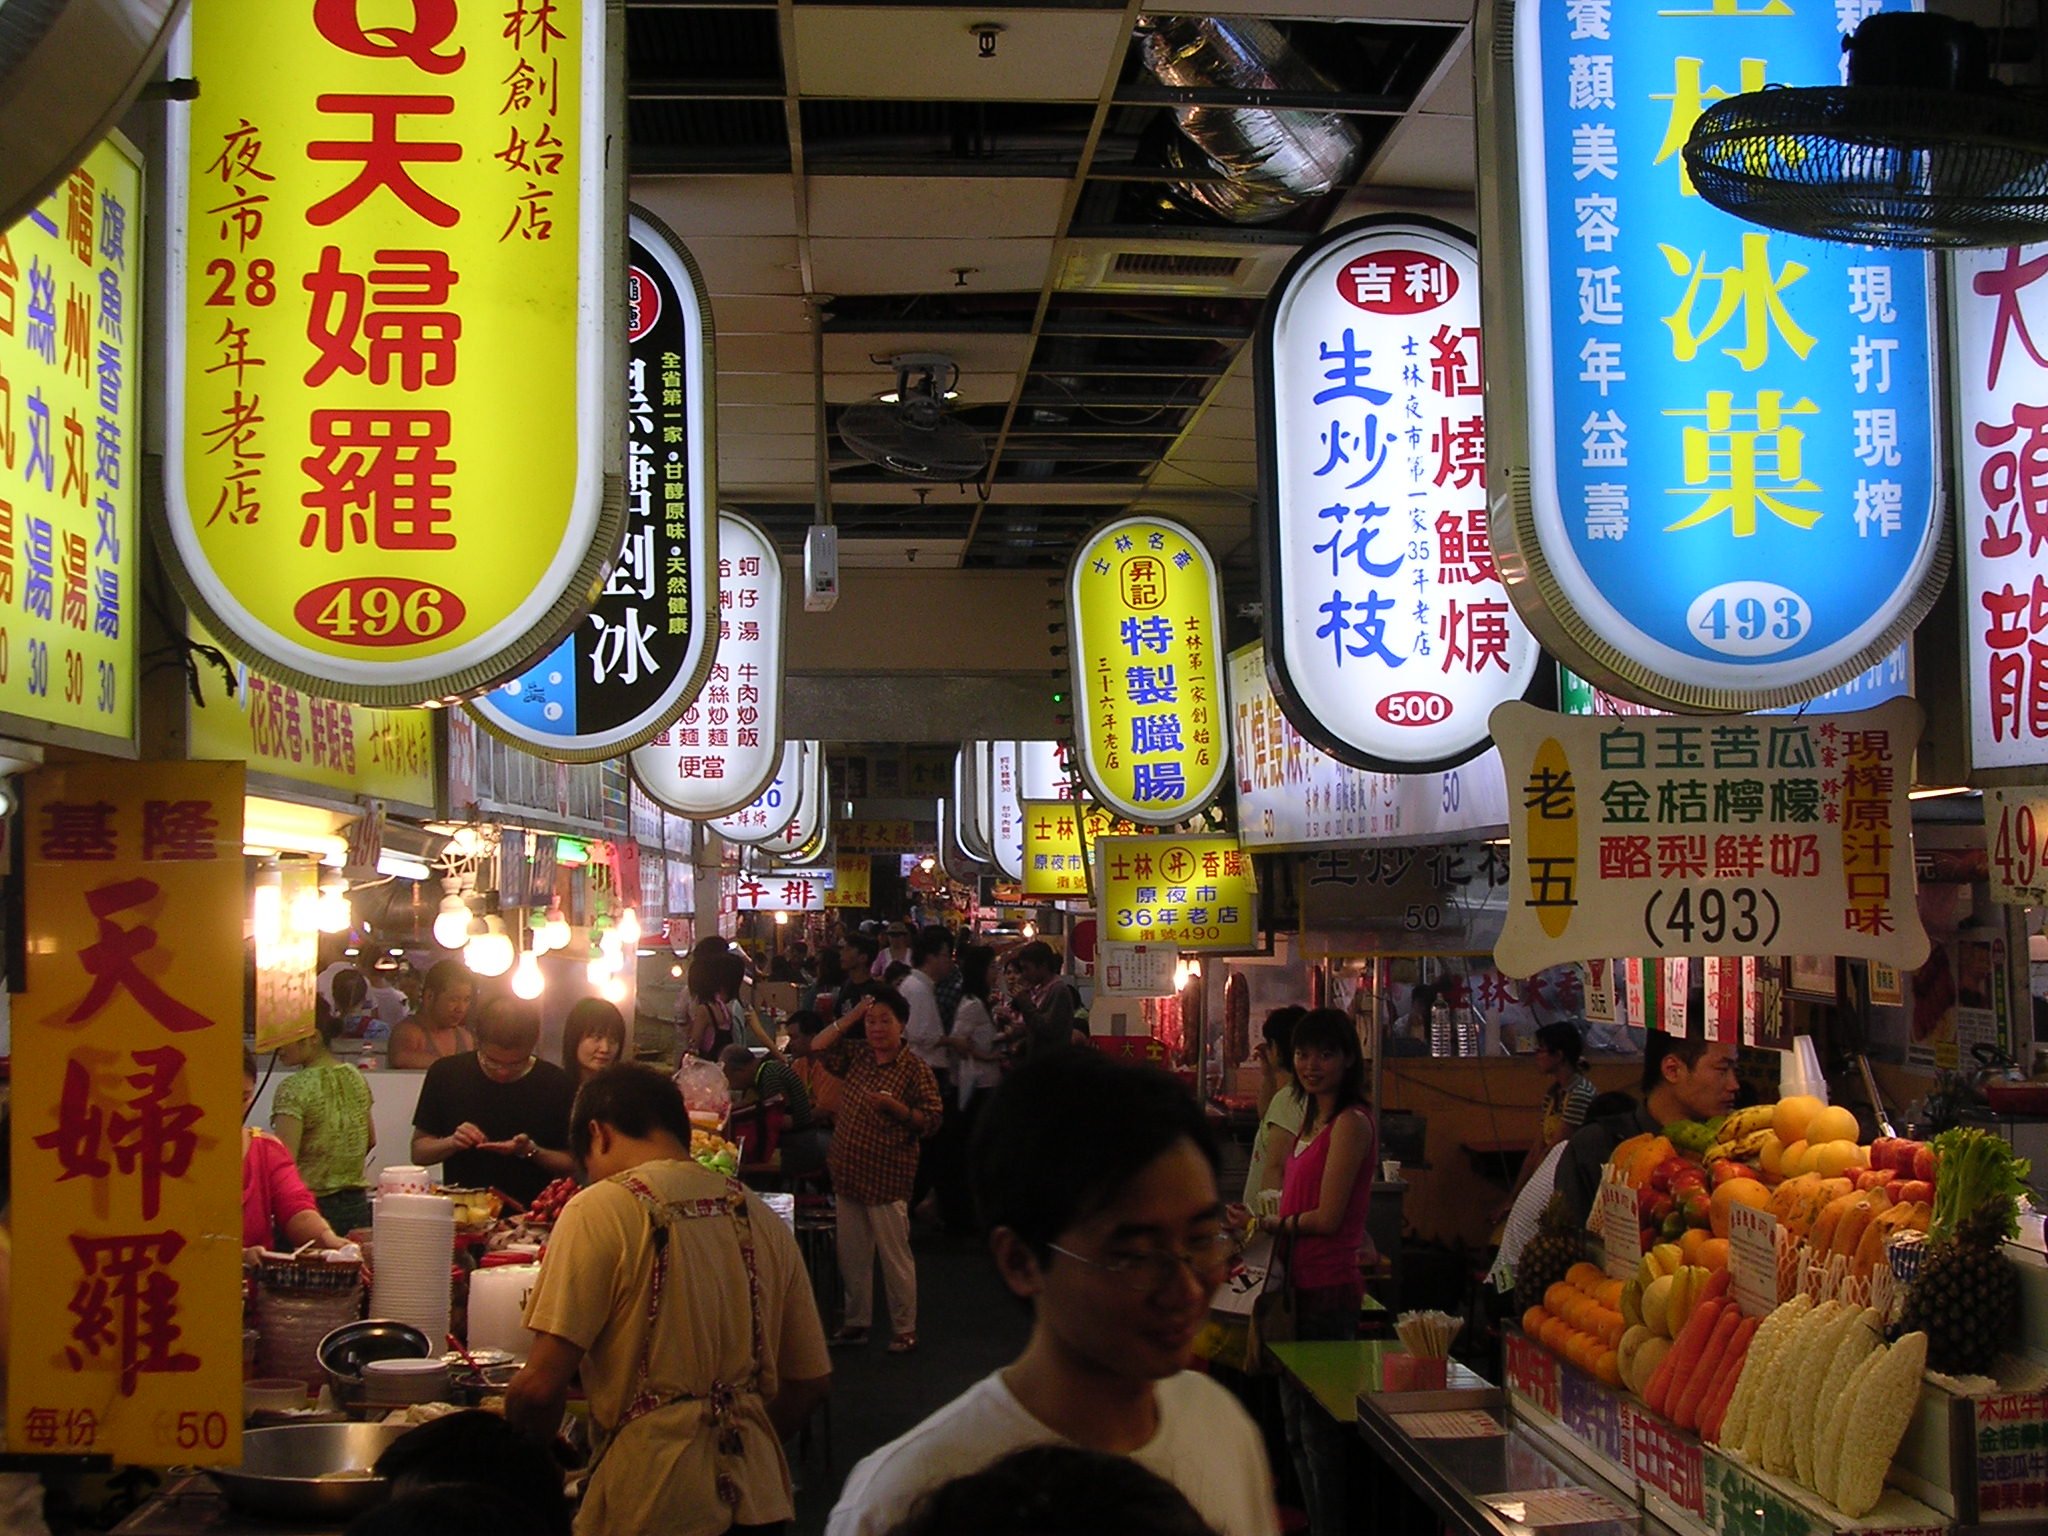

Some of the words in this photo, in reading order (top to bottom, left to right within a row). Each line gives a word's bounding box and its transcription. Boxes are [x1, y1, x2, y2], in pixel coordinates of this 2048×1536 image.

[1350, 262, 1449, 304] 吉利
[1313, 328, 1408, 668] 生炒花枝
[314, 588, 444, 629] 496
[738, 556, 760, 642] 蚵仔湯
[1699, 597, 1803, 640] 493
[737, 663, 759, 747] 牛肉炒飯
[1387, 696, 1446, 721] 500
[678, 755, 725, 779] 便當
[1600, 726, 1816, 769] 白玉苦瓜
[1442, 771, 1459, 812] 50
[1600, 779, 1820, 824] 金桔檸檬
[41, 801, 219, 861] 基隆
[1034, 817, 1074, 841] 士林
[1523, 767, 1578, 906] 老五
[1841, 730, 1895, 936] 現榨原汁口味
[1111, 854, 1152, 881] 士林
[1600, 834, 1820, 879] 酪梨鮮奶
[1136, 887, 1216, 904] 原夜市
[1117, 907, 1239, 927] 36年老店
[1406, 904, 1441, 930] 50
[33, 877, 216, 1398] 天婦羅
[26, 1407, 98, 1447] 每份
[176, 1411, 228, 1450] 50
[1978, 1394, 2048, 1421] 木瓜牛
[1978, 1453, 2048, 1481] 哈密瓜牛
